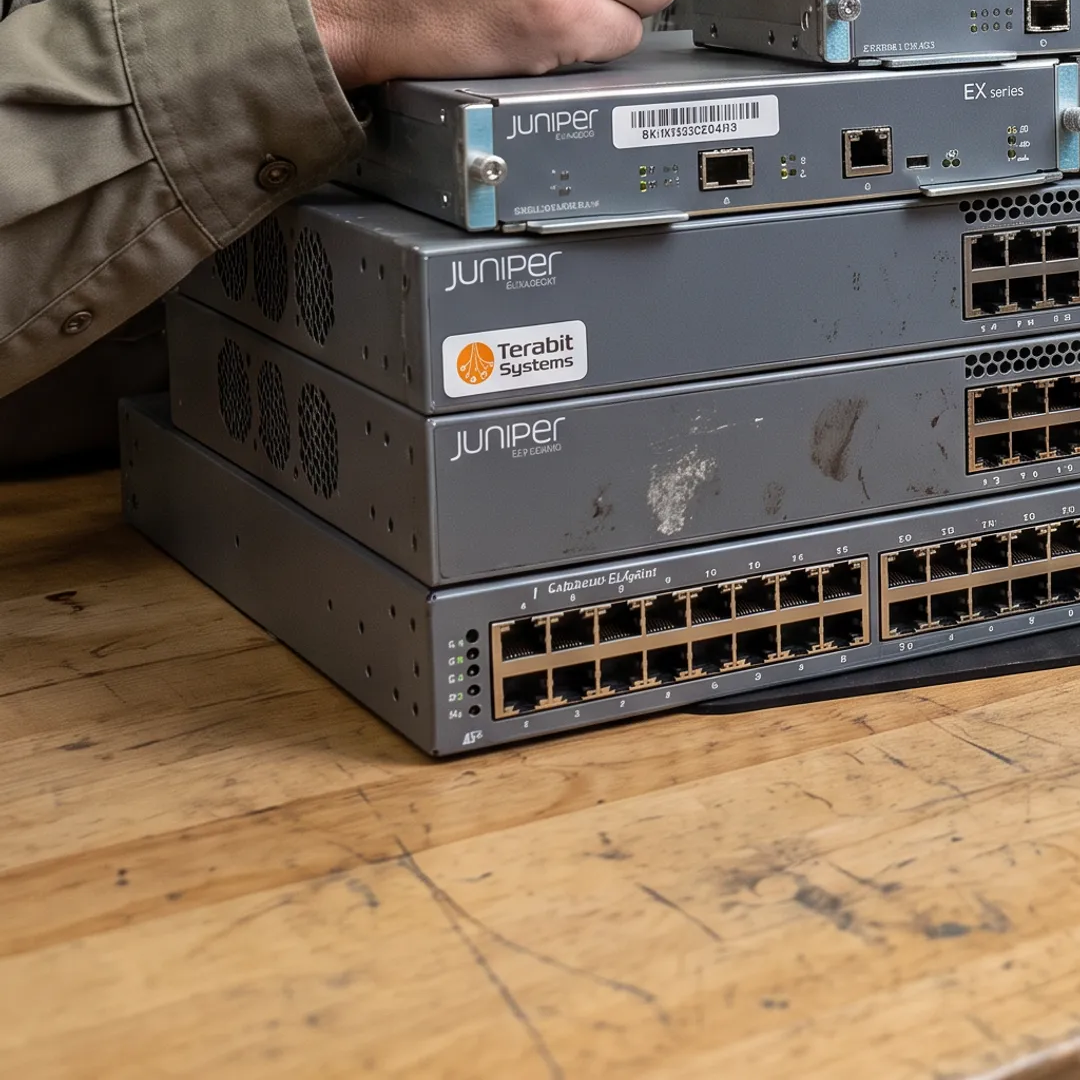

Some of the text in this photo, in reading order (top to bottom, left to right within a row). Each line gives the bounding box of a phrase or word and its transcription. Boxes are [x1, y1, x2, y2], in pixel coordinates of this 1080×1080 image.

[964, 83, 1024, 100] EX series
[498, 334, 574, 360] Terabit
[500, 356, 574, 378] Systems
